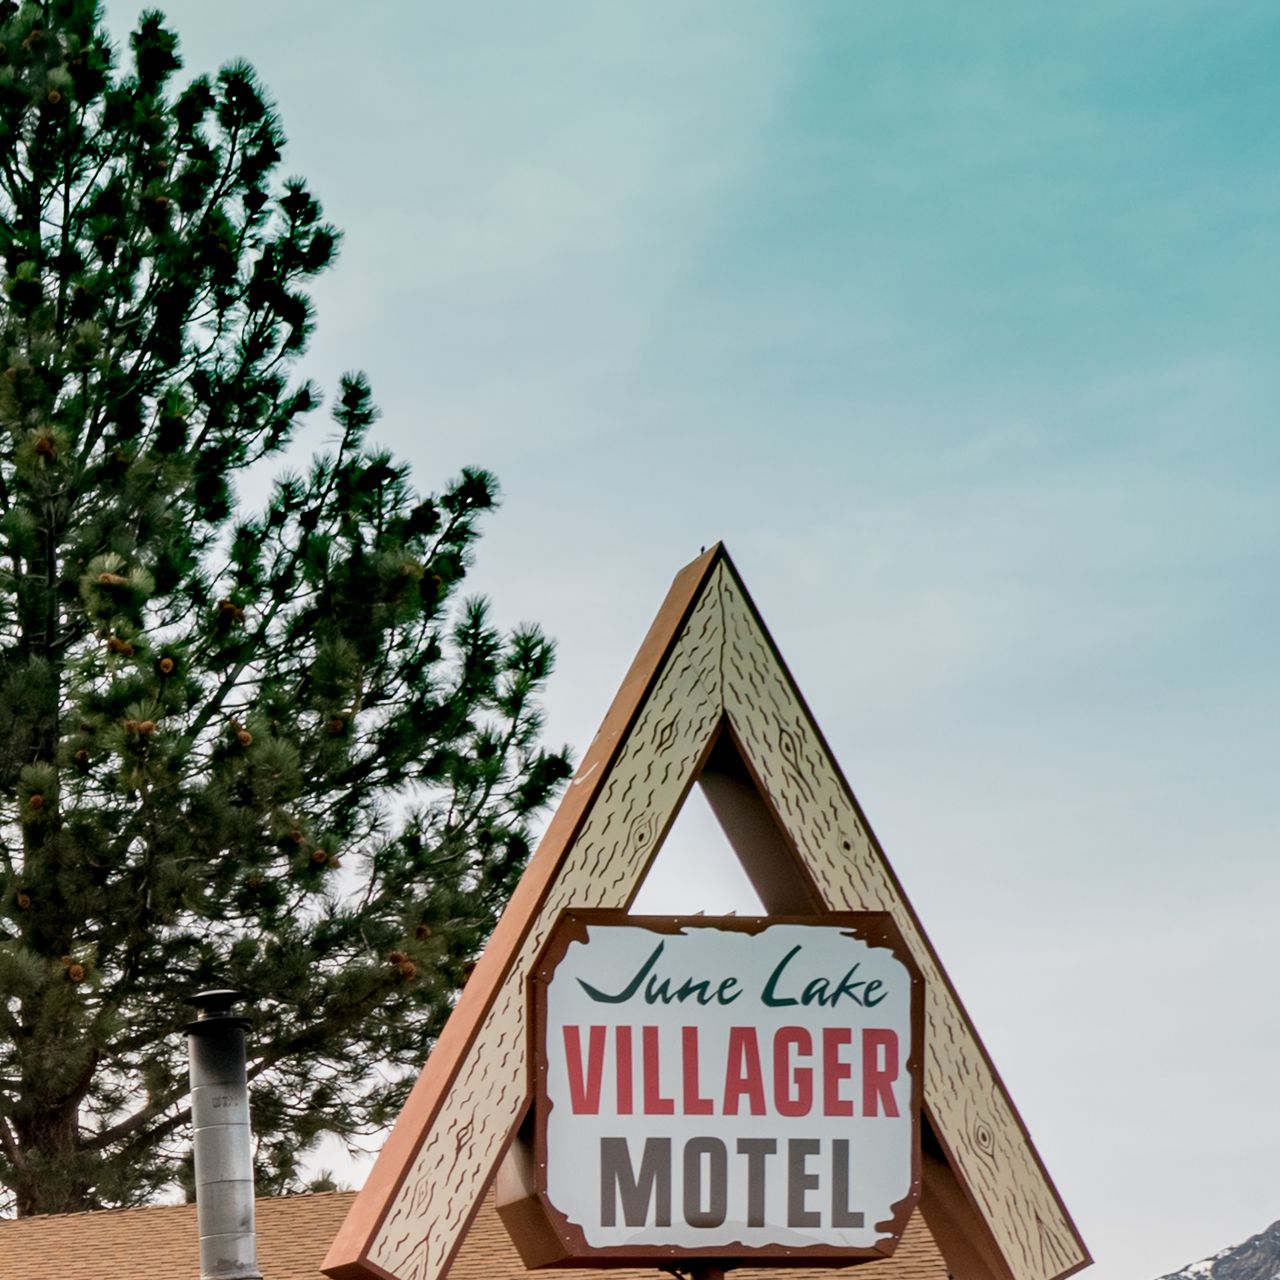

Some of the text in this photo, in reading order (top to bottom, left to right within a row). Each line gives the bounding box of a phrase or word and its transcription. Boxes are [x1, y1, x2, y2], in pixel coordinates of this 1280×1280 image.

[576, 939, 889, 1008] June Lake
[562, 1025, 901, 1118] VILLAGER
[600, 1136, 865, 1229] MOTEL
